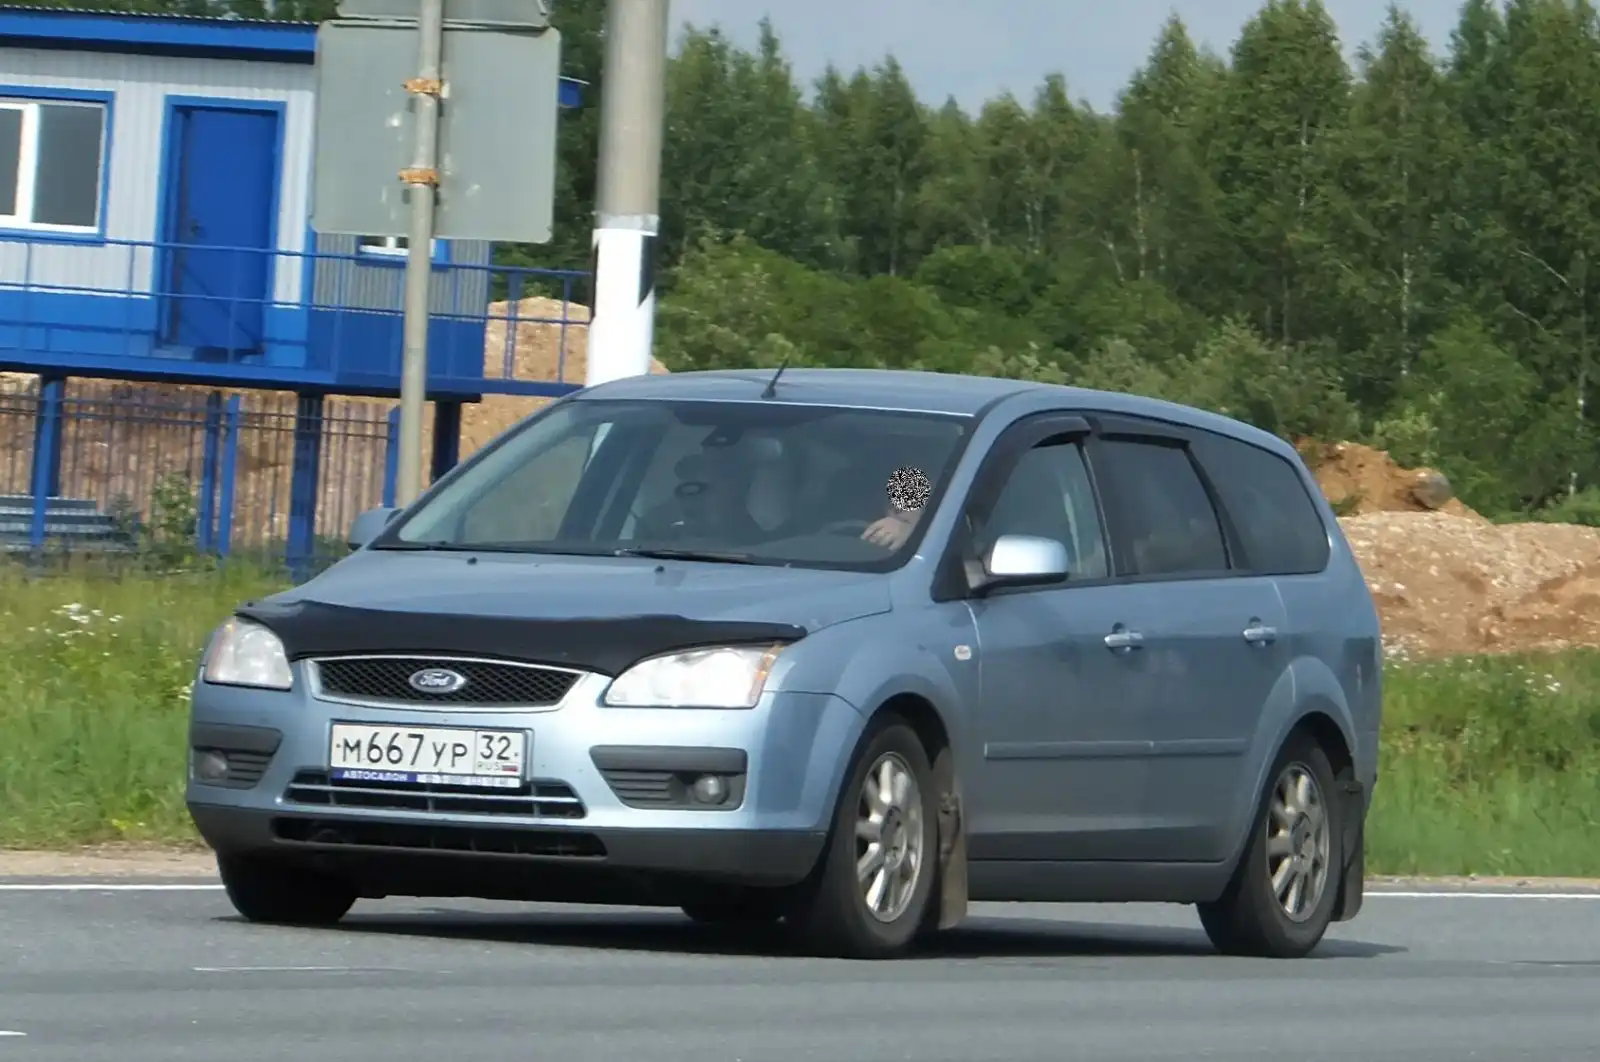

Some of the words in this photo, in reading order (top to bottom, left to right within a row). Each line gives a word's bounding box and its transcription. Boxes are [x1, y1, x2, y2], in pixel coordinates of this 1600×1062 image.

[420, 672, 450, 686] Ford
[480, 734, 511, 760] 32
[477, 761, 501, 771] RUS
[342, 770, 408, 782] АВТОСАЛОН
